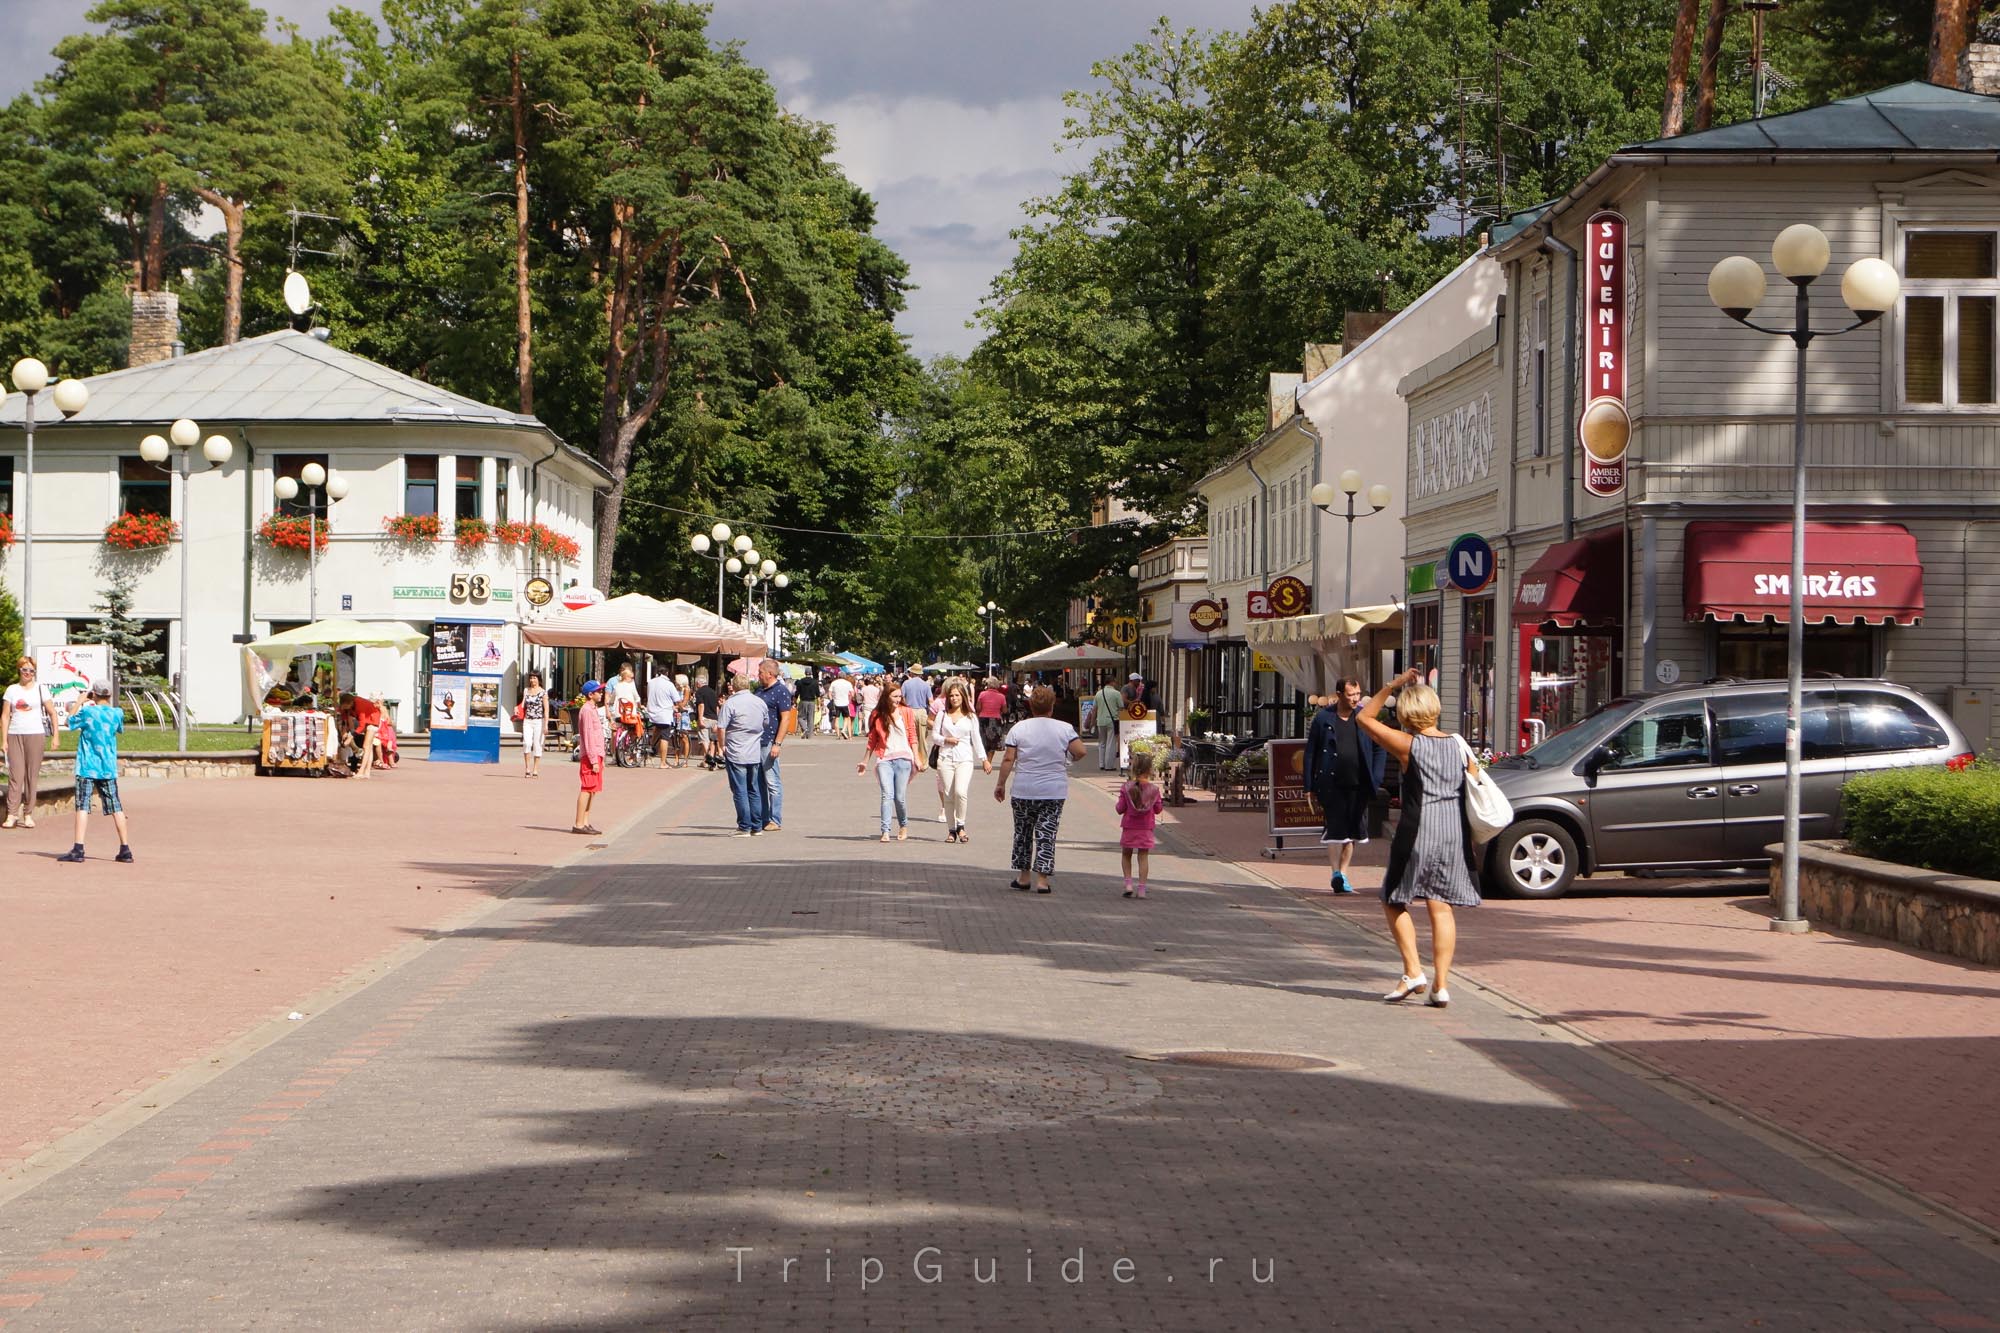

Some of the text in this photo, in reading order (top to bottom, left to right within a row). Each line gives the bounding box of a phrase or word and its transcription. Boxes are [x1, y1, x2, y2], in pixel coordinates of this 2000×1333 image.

[1599, 222, 1614, 389] SUVENĪRI
[1590, 467, 1621, 477] AMBER
[1591, 476, 1621, 485] STORE
[1458, 551, 1483, 576] N
[393, 588, 446, 598] KAFEJNICA
[451, 573, 491, 599] 53
[1754, 570, 1877, 598] SMRŽAS
[1277, 789, 1306, 800] SUVE
